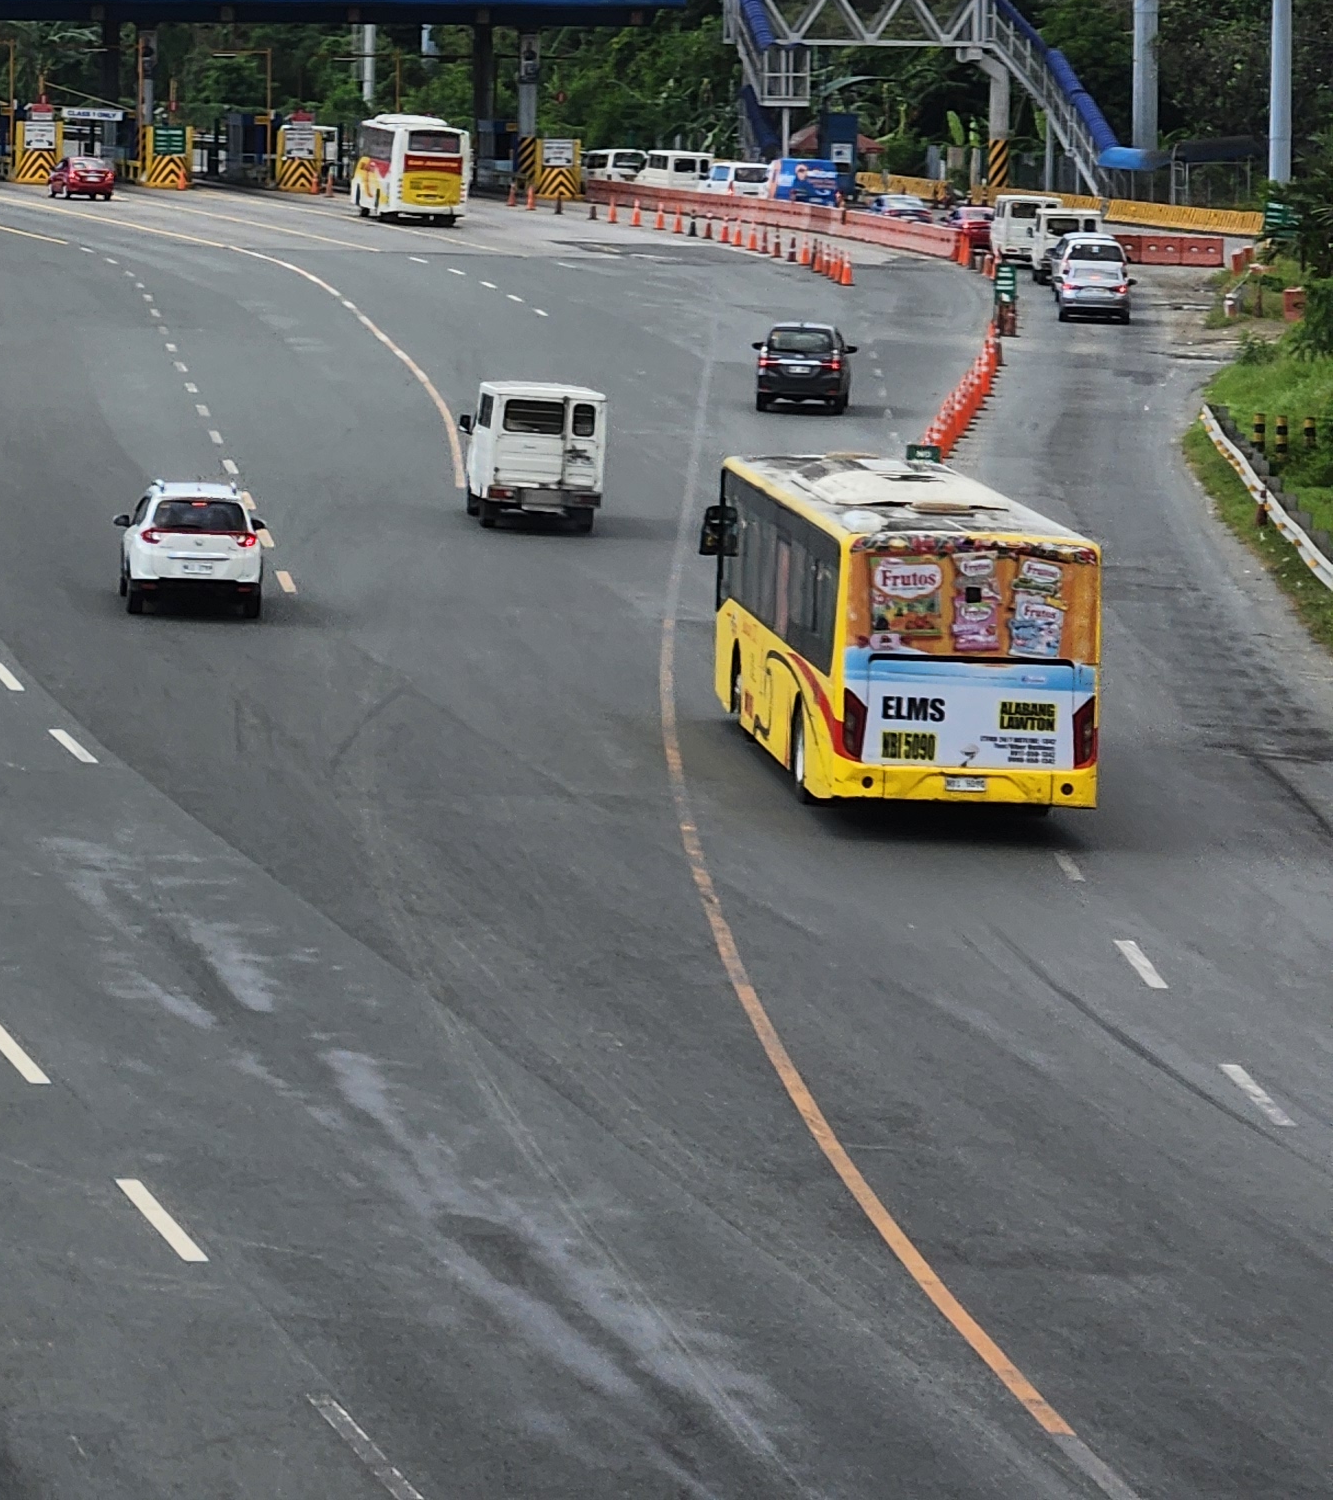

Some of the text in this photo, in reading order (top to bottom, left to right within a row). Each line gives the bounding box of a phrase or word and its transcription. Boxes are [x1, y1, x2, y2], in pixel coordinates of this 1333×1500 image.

[881, 569, 936, 587] Frutos
[882, 696, 945, 722] ELMS
[1000, 702, 1055, 717] ALABANG
[1000, 715, 1055, 731] LAWTON
[882, 732, 935, 761] NBI 5090
